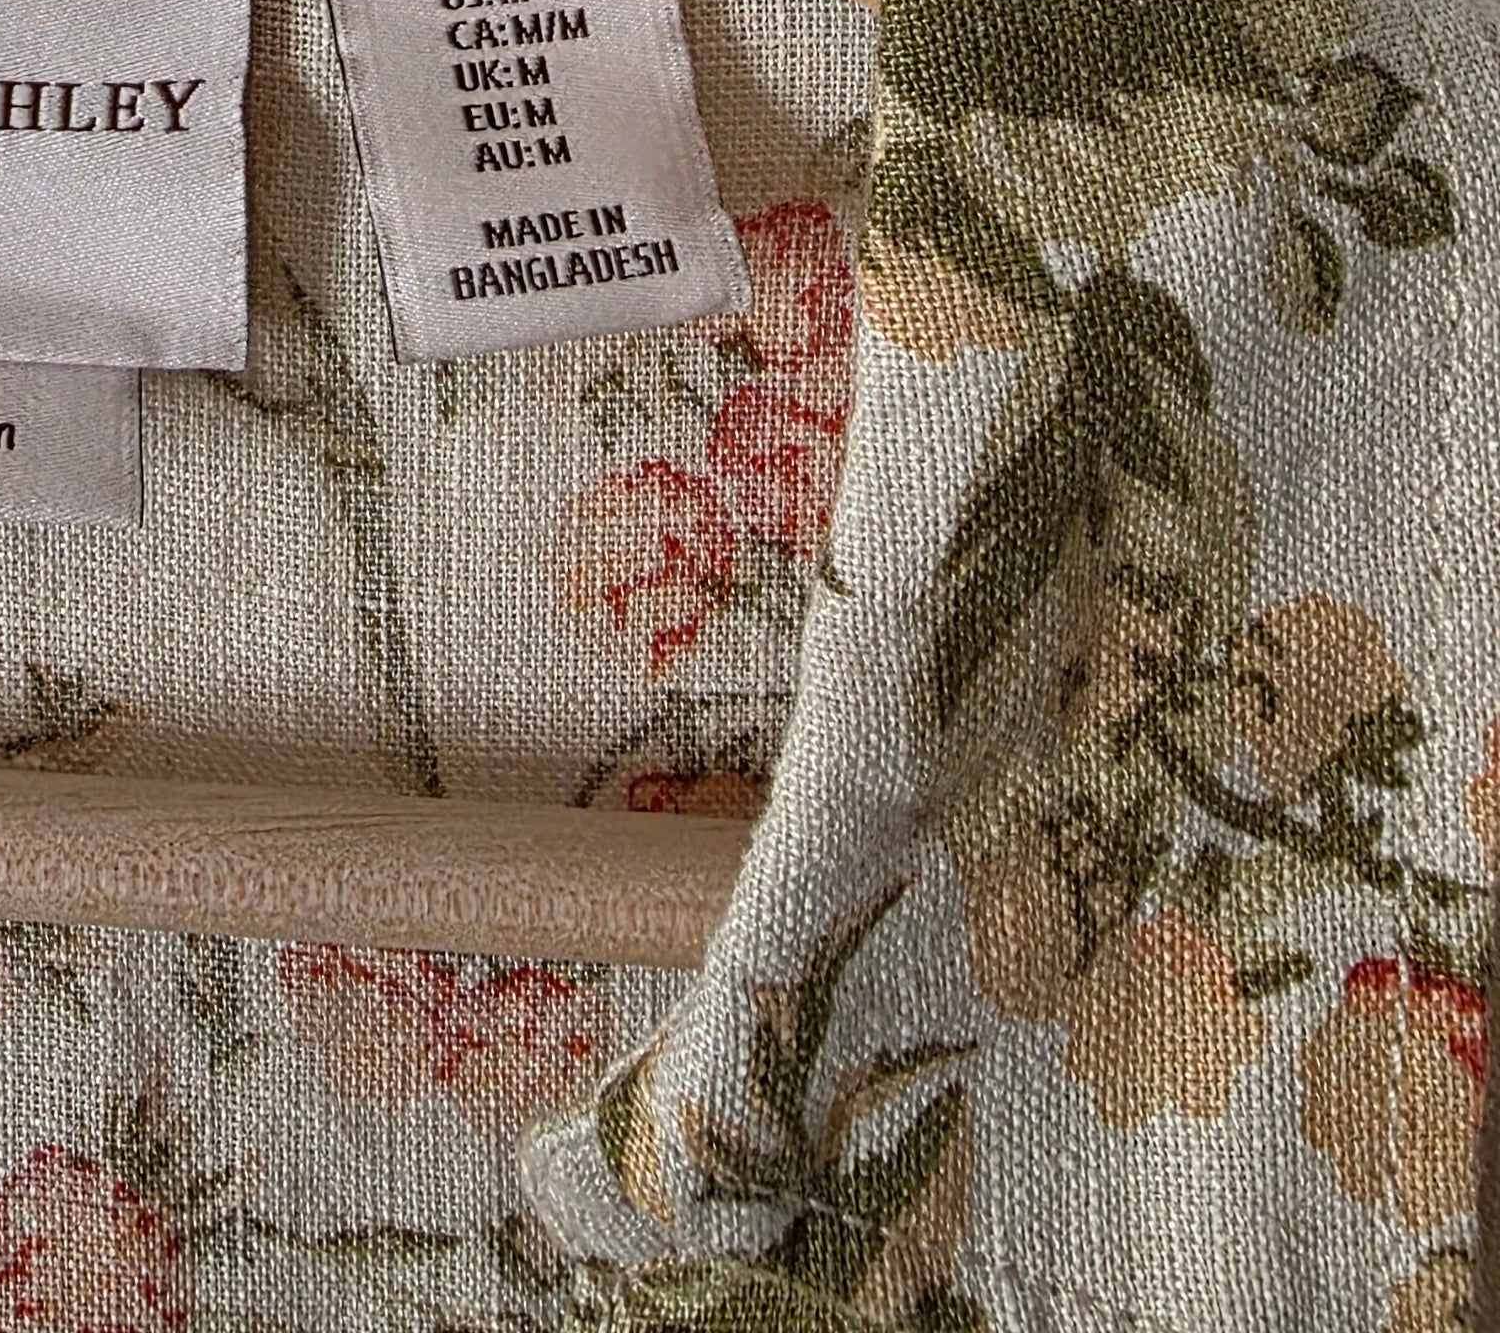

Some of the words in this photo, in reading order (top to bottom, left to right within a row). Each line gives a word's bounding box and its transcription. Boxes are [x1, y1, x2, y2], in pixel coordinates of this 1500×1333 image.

[481, 209, 581, 250] MADE
[587, 203, 628, 236] IN
[449, 238, 680, 301] BANGLADESH
